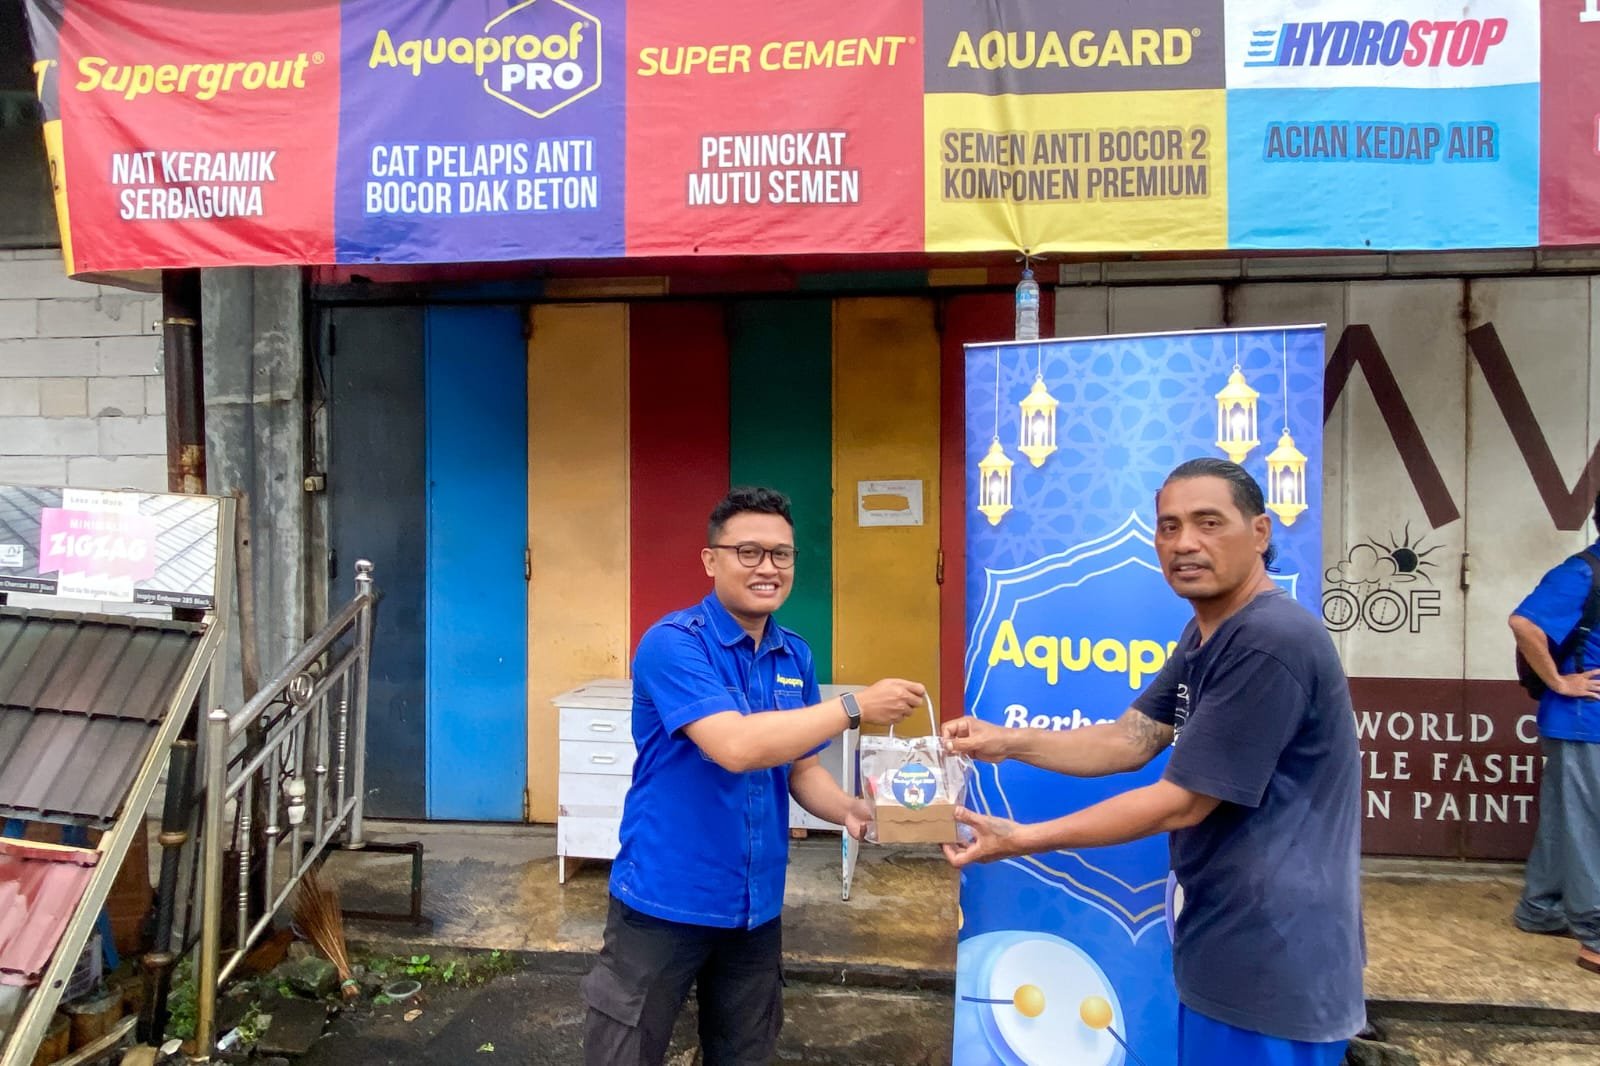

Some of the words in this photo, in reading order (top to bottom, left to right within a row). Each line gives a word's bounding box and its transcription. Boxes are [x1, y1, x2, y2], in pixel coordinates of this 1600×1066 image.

[369, 22, 583, 77] Aquaproof
[637, 45, 751, 77] SUPER
[759, 36, 906, 71] CEMENT
[947, 28, 1192, 69] AQUAGARD
[1278, 18, 1508, 67] HYDROSTOP
[75, 52, 309, 101] Supergrout
[501, 62, 583, 92] PRO
[371, 146, 418, 176] CAT
[426, 143, 528, 176] PELAPIS
[535, 140, 593, 171] ANTI
[701, 132, 846, 168] PENINGKAT
[943, 132, 1026, 164] SEMEN
[1032, 132, 1094, 165] ANTI
[1100, 131, 1183, 162] BOCOR
[1191, 130, 1207, 160] 2
[1267, 126, 1347, 158] ACIAN
[1355, 126, 1440, 159] KEDAP
[1447, 126, 1494, 158] AIR
[112, 152, 157, 184] NAT
[164, 151, 276, 182] KERAMIK
[944, 167, 1079, 200] KOMPONEN
[1087, 165, 1207, 198] PREMIUM
[120, 187, 263, 219] SERBAGUNA
[366, 181, 451, 214] BOCOR
[459, 180, 508, 212] DAK
[515, 177, 598, 210] BETON
[688, 172, 761, 205] MUTU
[768, 171, 859, 204] SEMEN
[48, 531, 147, 562] ZIGZAG
[1353, 711, 1494, 743] WORLD
[1359, 750, 1411, 780] LE
[1413, 791, 1534, 824] PAINT
